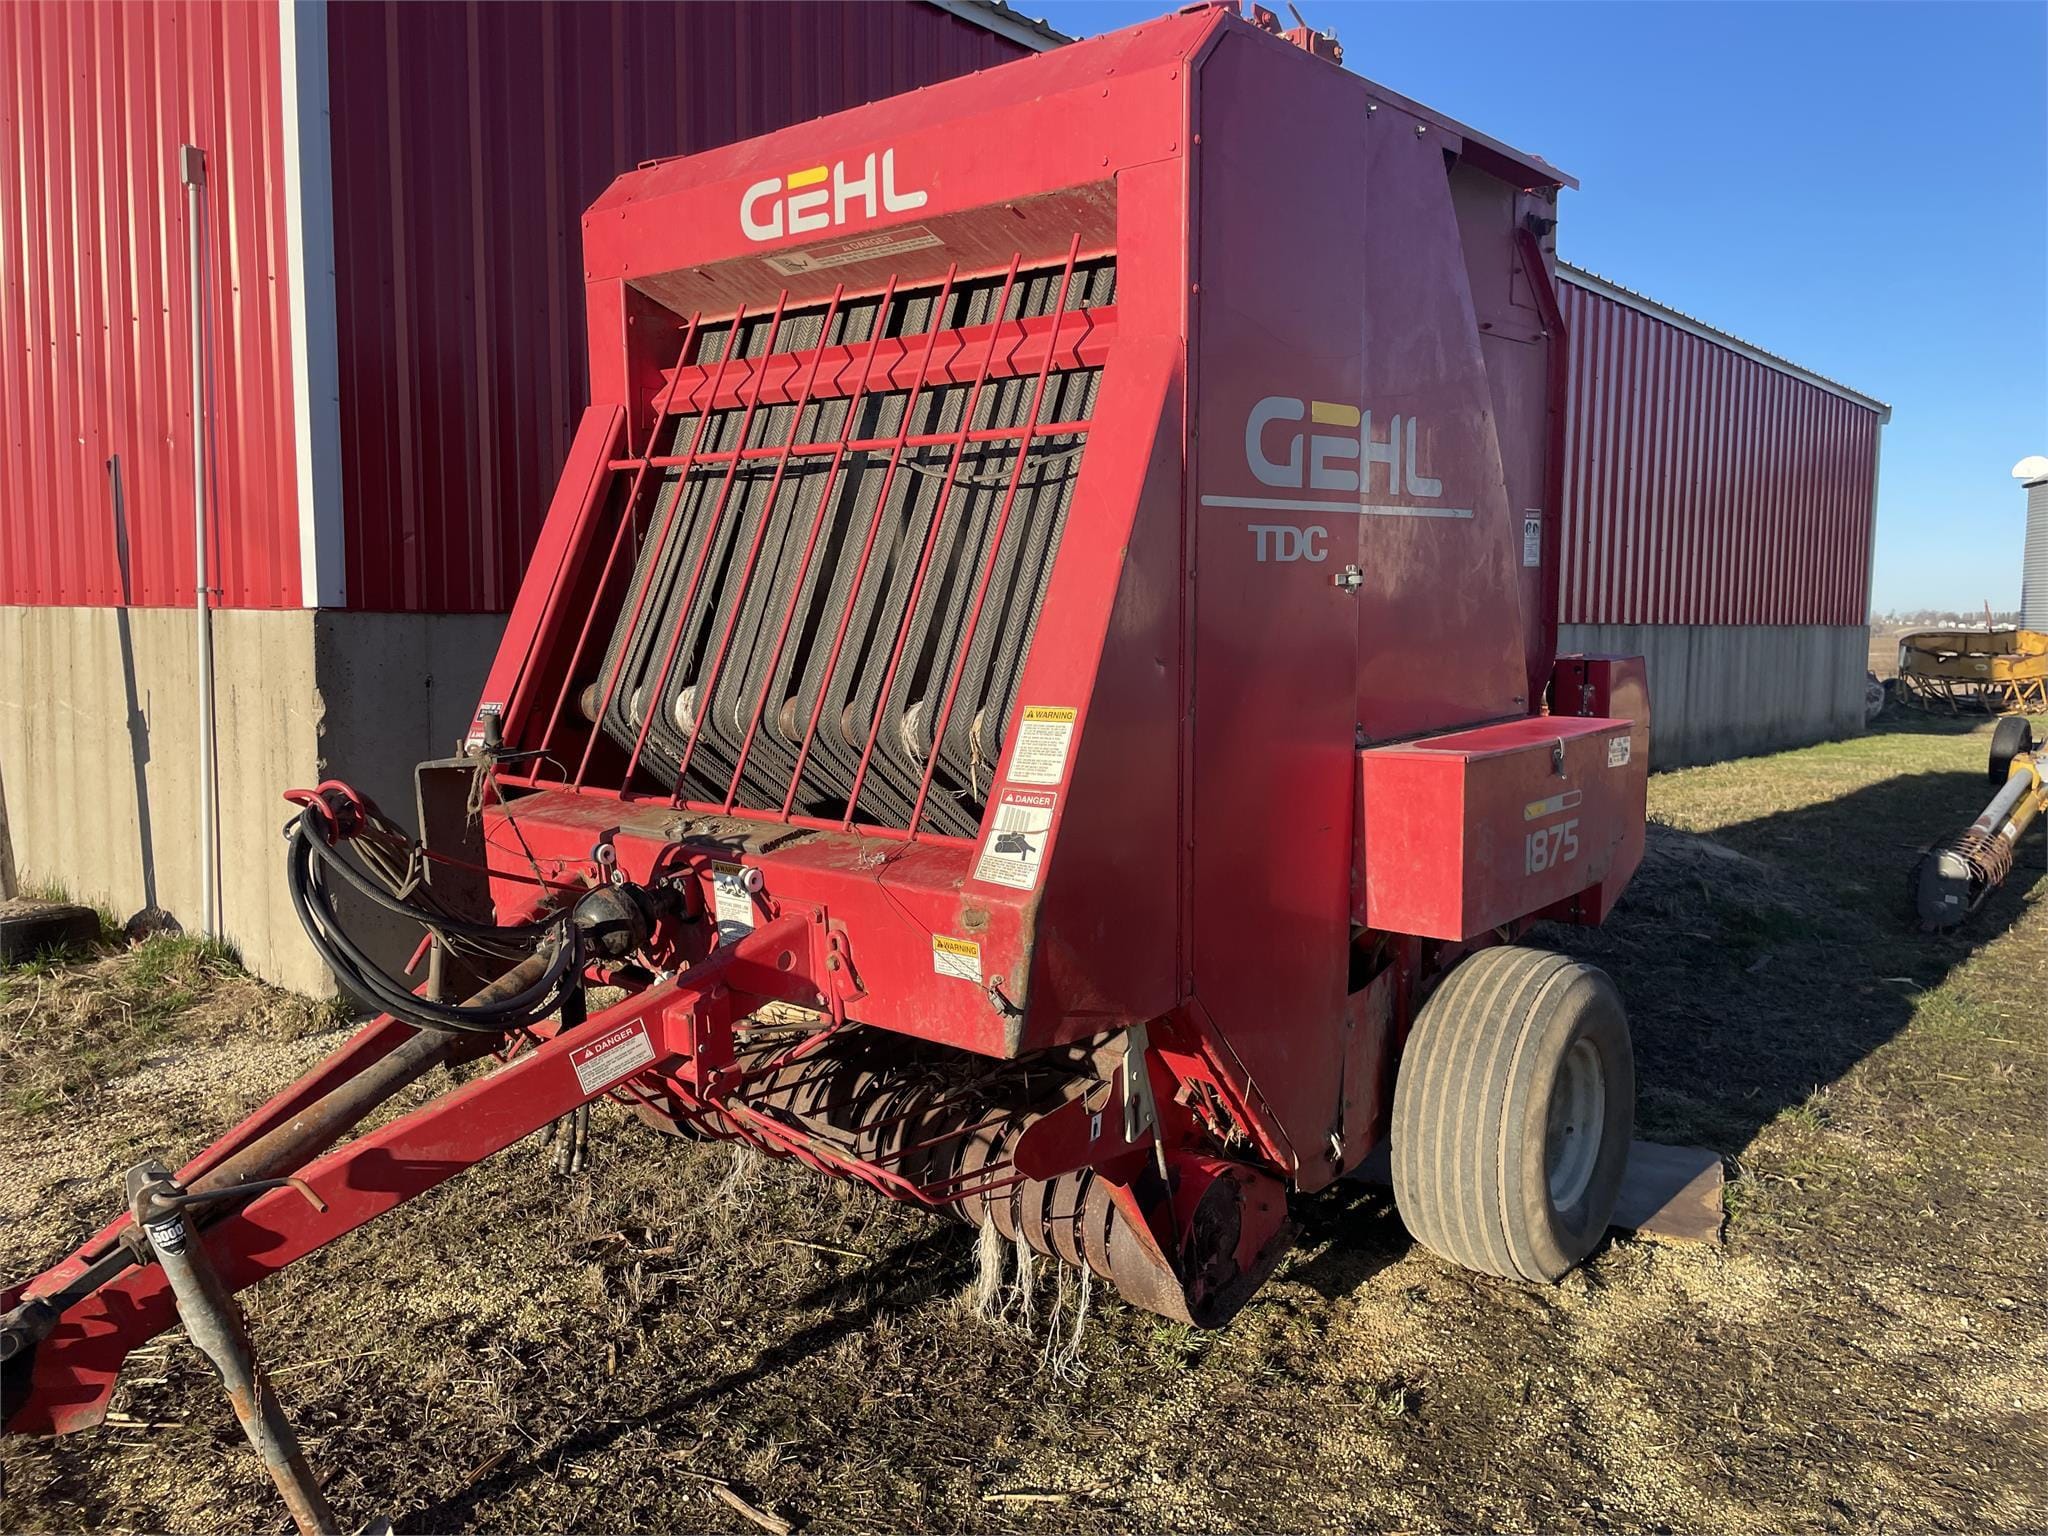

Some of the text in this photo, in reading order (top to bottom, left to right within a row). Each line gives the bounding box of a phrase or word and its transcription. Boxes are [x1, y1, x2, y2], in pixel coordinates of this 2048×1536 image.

[740, 148, 928, 241] GEHL
[850, 236, 894, 250] DANGER
[1245, 396, 1443, 498] GEHL
[1247, 524, 1328, 562] TDC
[1035, 711, 1073, 720] WARNING
[1015, 795, 1050, 806] DANGER
[1525, 818, 1579, 877] 1875
[943, 941, 977, 955] WARNING
[594, 1028, 634, 1053] DANGER
